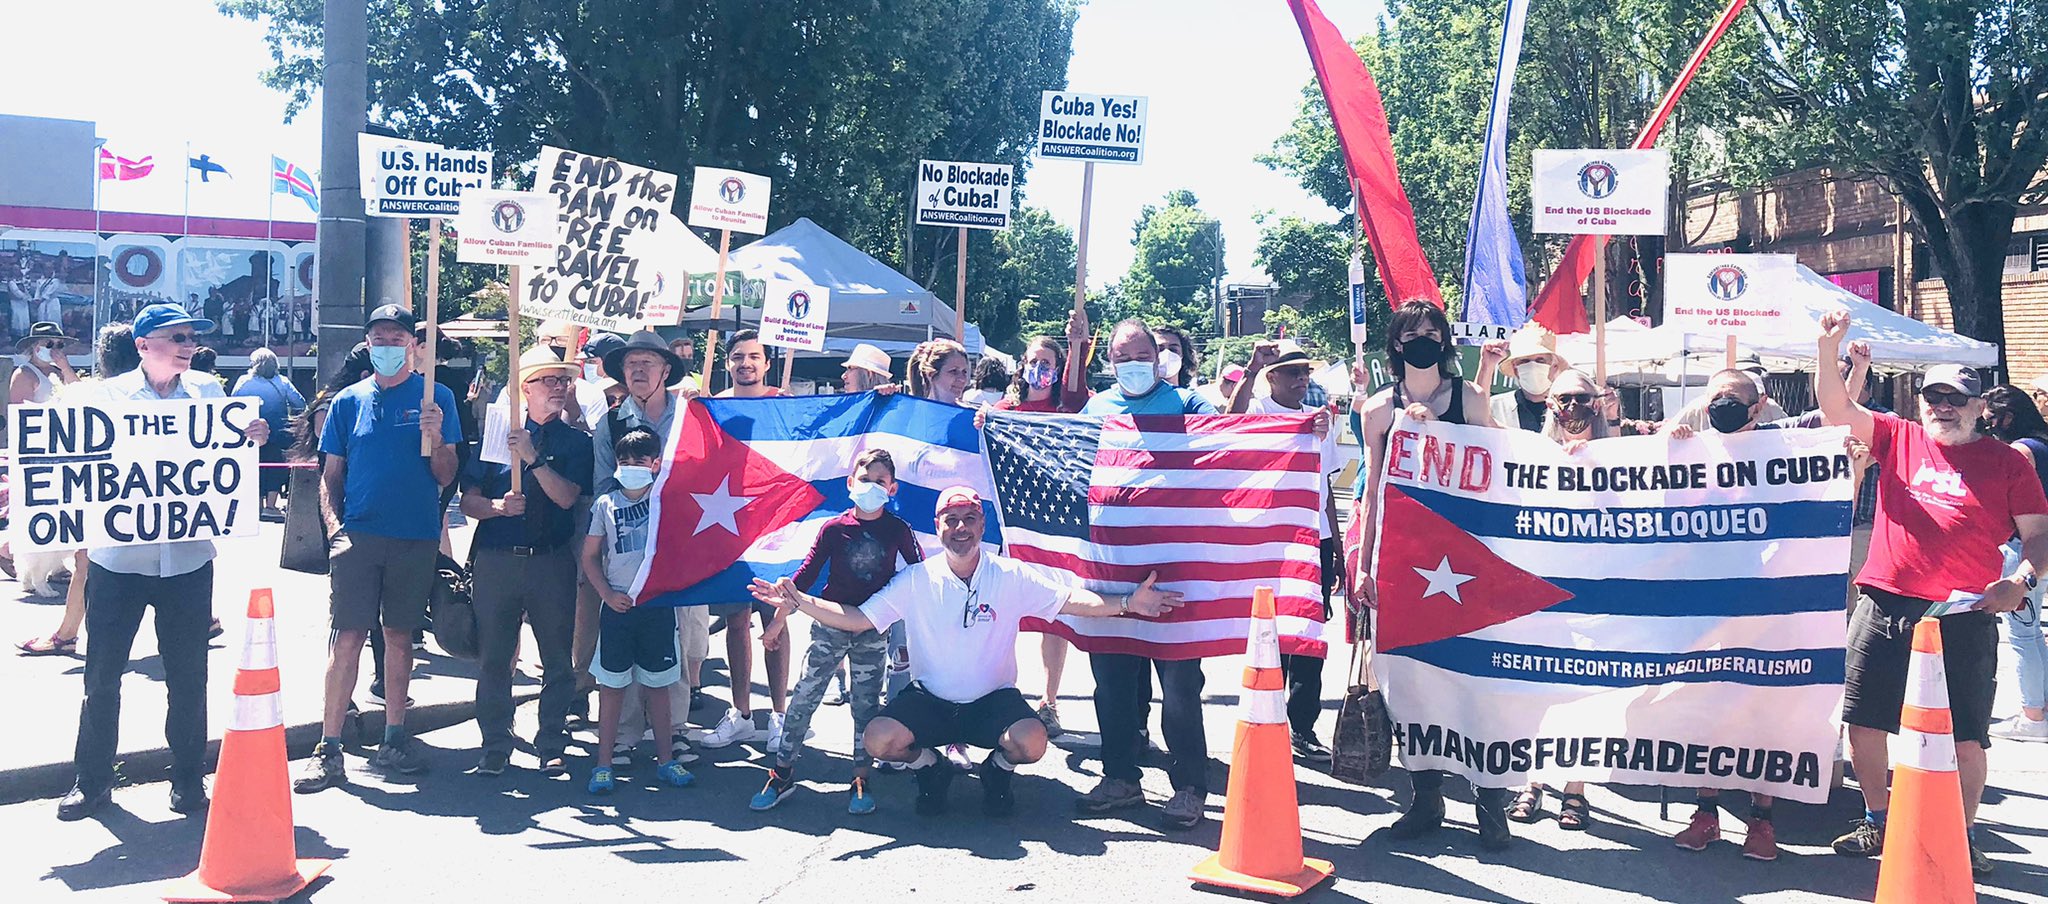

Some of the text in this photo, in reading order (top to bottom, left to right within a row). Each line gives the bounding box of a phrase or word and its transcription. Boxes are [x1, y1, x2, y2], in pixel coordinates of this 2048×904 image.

[1051, 95, 1138, 119] Cuba Yes!
[1043, 119, 1141, 144] Blockade No!
[381, 151, 487, 174] U.S. Hands
[1043, 145, 1136, 161] ANSWERCoalition.org
[552, 152, 672, 203] END the
[922, 163, 1010, 187] No Blockade
[385, 175, 417, 196] Off
[382, 200, 460, 211] ANSWERCoalitio
[928, 186, 999, 209] of Cuba!
[623, 206, 659, 232] on
[693, 204, 766, 220] Allow Cuban Families
[720, 215, 747, 225] Reunite
[922, 211, 1004, 225] ANSWERCoalition.org
[1545, 206, 1563, 214] End
[1586, 207, 1600, 215] US
[1603, 207, 1651, 215] Blockade
[1577, 217, 1617, 225] of Cuba
[463, 237, 553, 249] Allow Cuban Families
[485, 247, 529, 257] to Reunite
[547, 245, 639, 288] RAVEL
[687, 279, 734, 296] TION
[568, 279, 651, 320] CUBA!
[1675, 307, 1693, 315] End
[1716, 308, 1730, 316] US
[764, 316, 781, 324] Build
[782, 318, 805, 328] Bridges
[783, 327, 808, 336] between
[1707, 318, 1746, 326] of Cuba
[1451, 324, 1508, 340] LLAR
[18, 402, 254, 455] END THE U.S.
[1388, 429, 1850, 493] END THE BLOCKADE ON CUBA
[24, 457, 241, 507] EMBARGO
[28, 499, 239, 545] ON CUBA!
[1491, 651, 1812, 678] #SEATTLECONTRAELNEOLIBERALISMO
